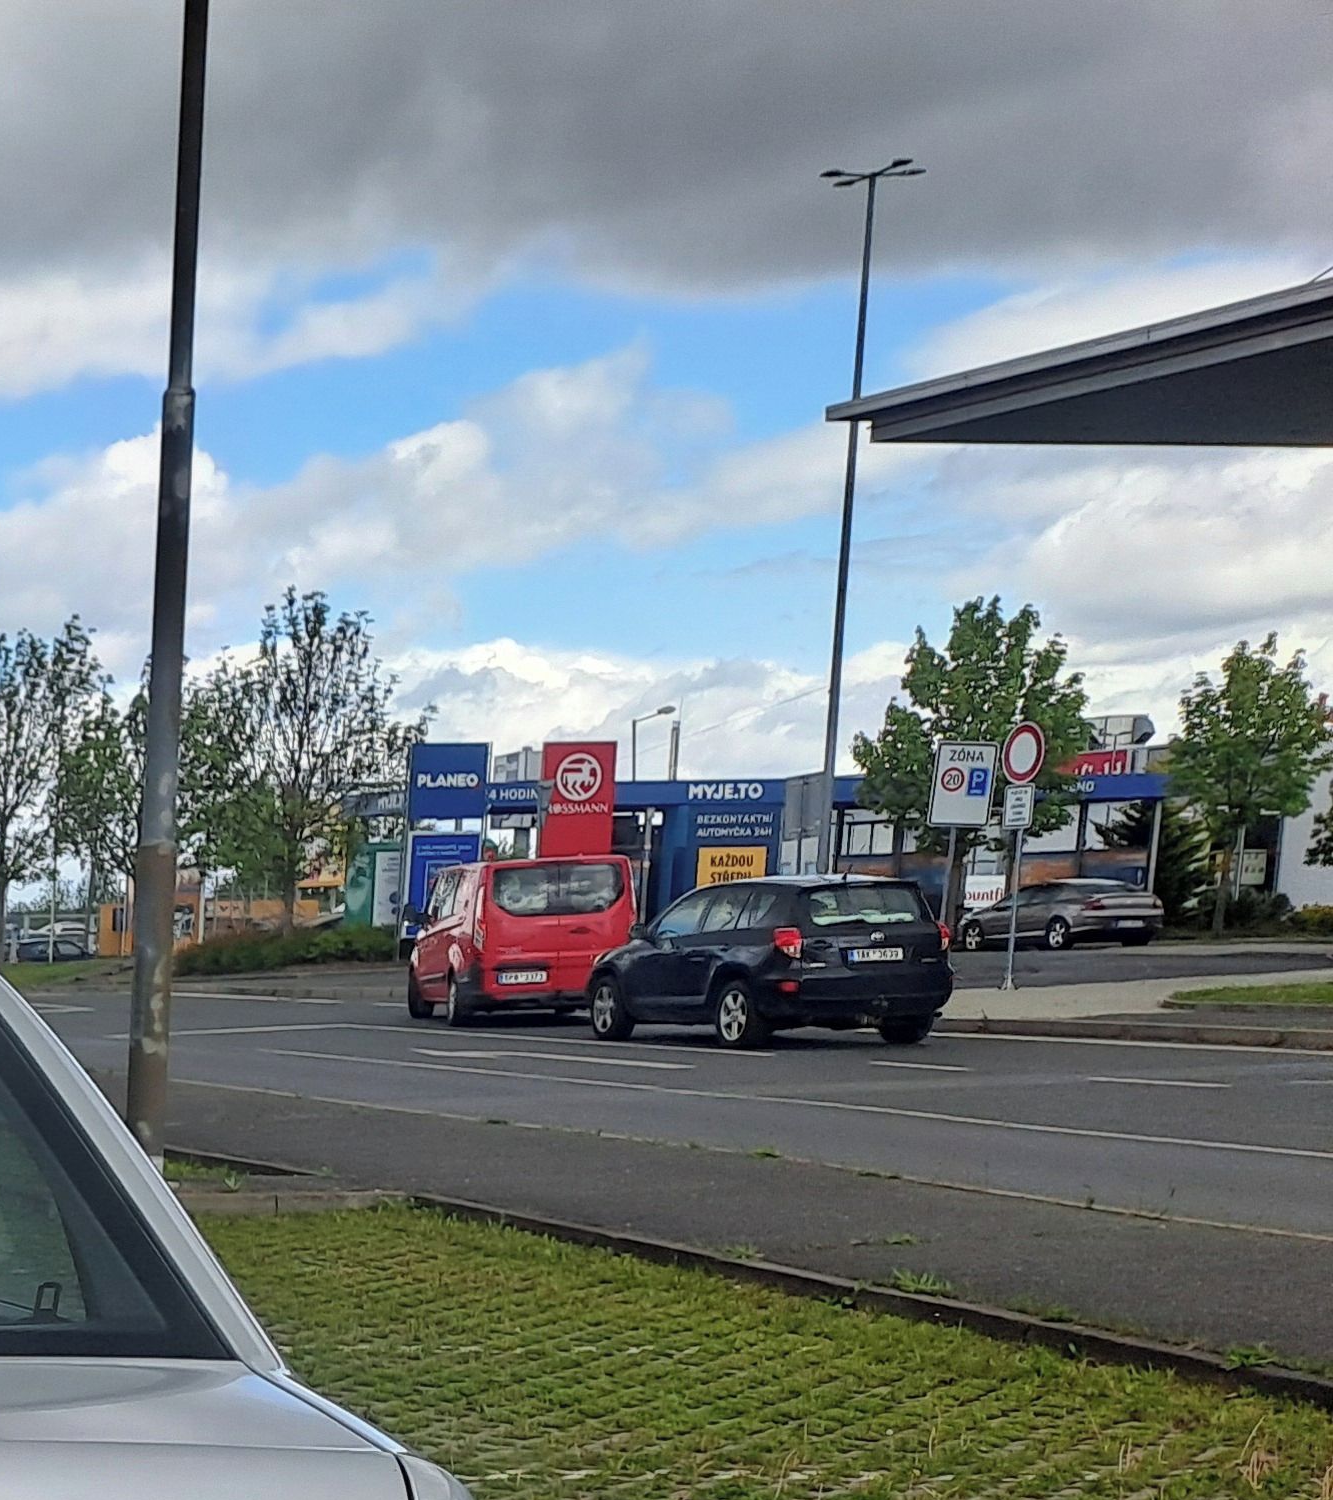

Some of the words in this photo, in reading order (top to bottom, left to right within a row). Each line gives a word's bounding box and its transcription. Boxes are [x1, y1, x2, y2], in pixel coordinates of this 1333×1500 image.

[949, 747, 984, 762] ZÓNA
[417, 773, 479, 788] PLANEO
[946, 774, 960, 786] 20
[688, 783, 764, 800] MYJE.TO
[710, 853, 754, 867] KAŽDOU
